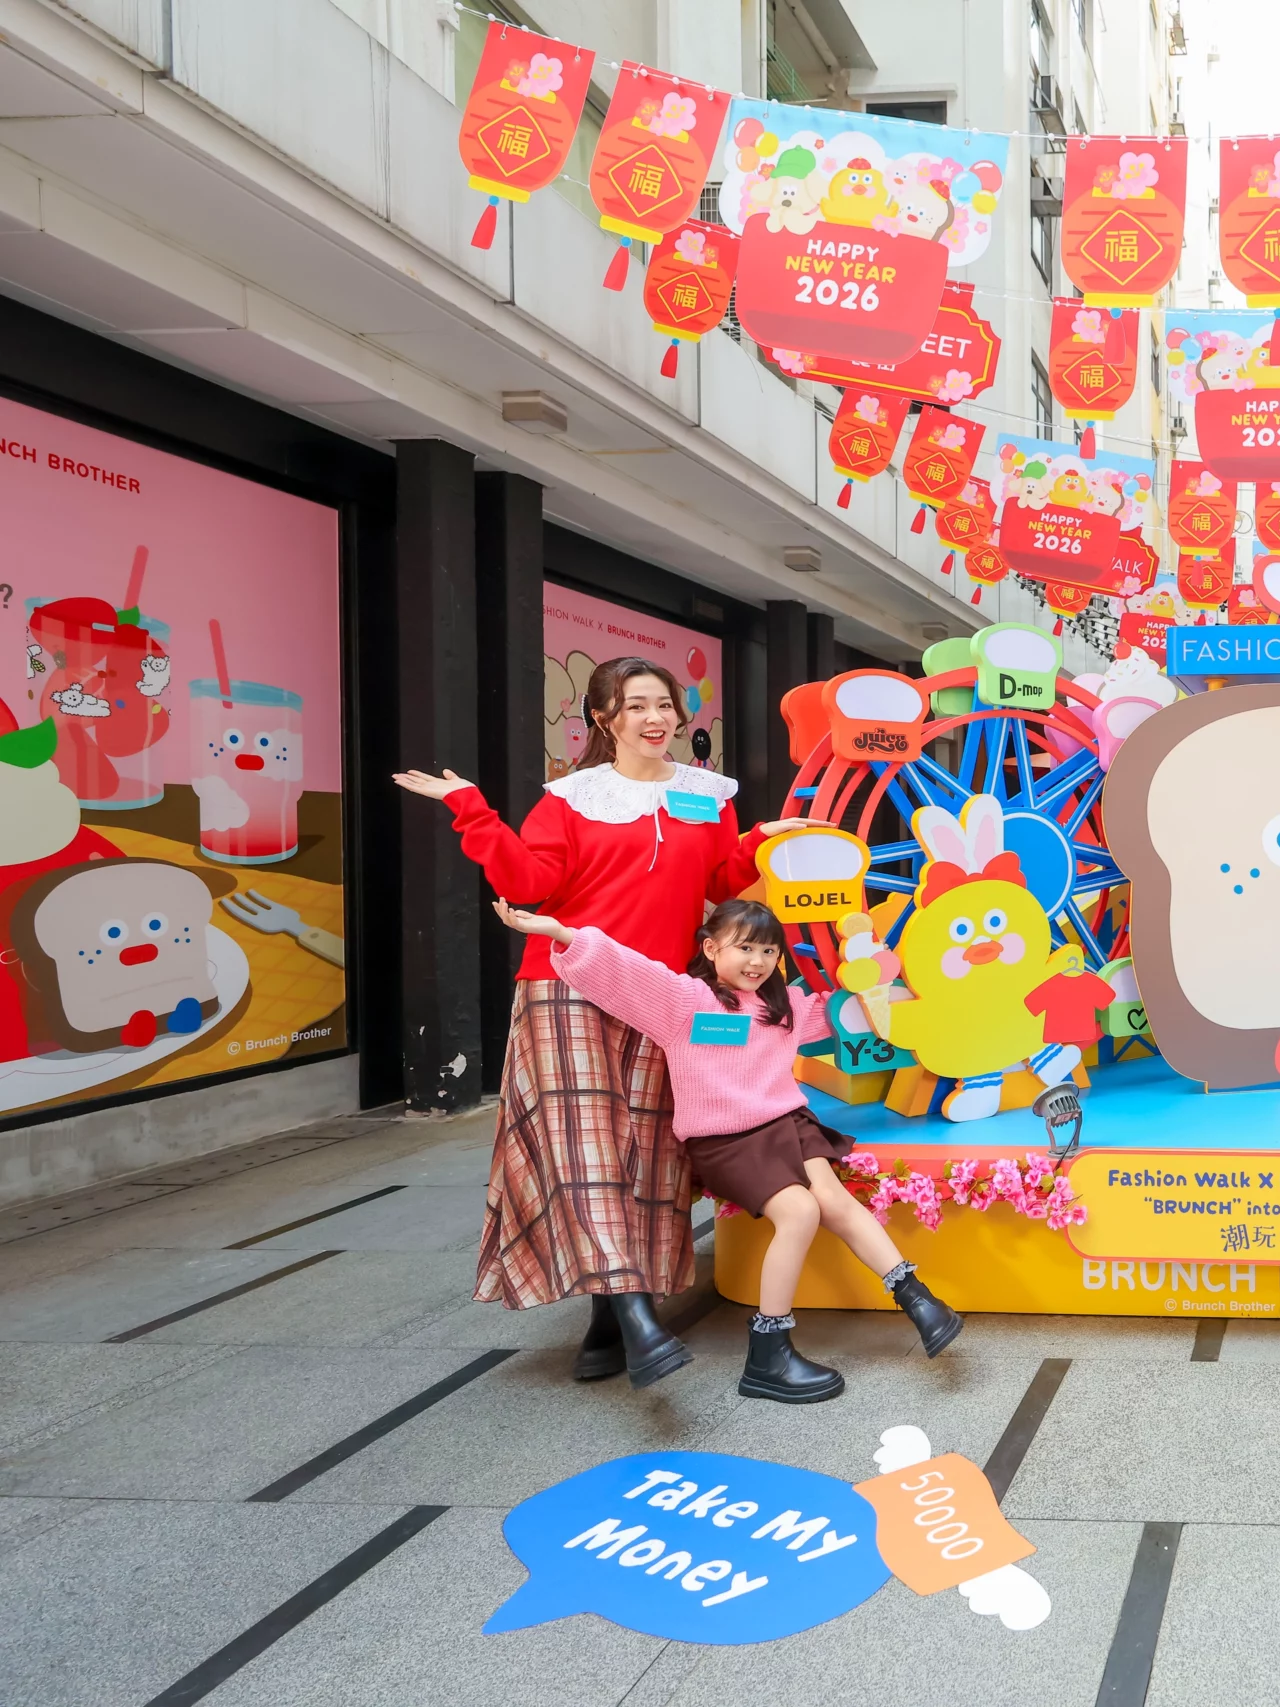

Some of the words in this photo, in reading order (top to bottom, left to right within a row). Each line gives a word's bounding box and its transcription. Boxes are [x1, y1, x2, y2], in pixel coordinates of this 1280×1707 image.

[497, 123, 532, 158] 福
[629, 162, 665, 198] 福
[807, 239, 879, 262] HAPPY
[1105, 231, 1138, 262] 福
[786, 256, 834, 274] NEW
[841, 262, 896, 283] YEAR
[673, 284, 699, 309] 福
[795, 276, 879, 311] 2026
[1080, 365, 1104, 388] 福
[1232, 414, 1268, 425] NEW
[850, 436, 870, 457] 福
[48, 454, 140, 493] BROTHER
[926, 462, 947, 482] 福
[954, 516, 971, 532] 福
[1029, 520, 1057, 536] NEW
[1061, 526, 1091, 540] YEAR
[1039, 513, 1082, 529] HAPPY
[1192, 513, 1210, 530] 福
[1034, 533, 1082, 554] 2026
[981, 556, 995, 569] 福
[1112, 557, 1143, 575] ALK
[572, 613, 595, 629] WALK
[597, 620, 603, 632] X
[608, 625, 634, 640] BRUNCH
[638, 634, 665, 649] BROTHER
[1137, 627, 1158, 636] NEW
[1146, 621, 1174, 631] HAPP
[1000, 673, 1042, 699] D-mop
[785, 893, 851, 907] LOJEL
[246, 1035, 287, 1050] Brunch
[291, 1028, 331, 1042] Brother
[842, 1037, 896, 1066] Y-3
[1109, 1170, 1186, 1187] Fashion
[1195, 1172, 1250, 1188] Walk
[1258, 1173, 1273, 1188] X
[1248, 1201, 1280, 1215] into
[1081, 1258, 1257, 1294] BRUNCH
[1182, 1300, 1226, 1310] Brunch
[1230, 1301, 1275, 1311] Brother
[622, 1469, 759, 1528] Take
[750, 1509, 859, 1563] My
[899, 1471, 985, 1561] 50000
[562, 1517, 770, 1608] Money
